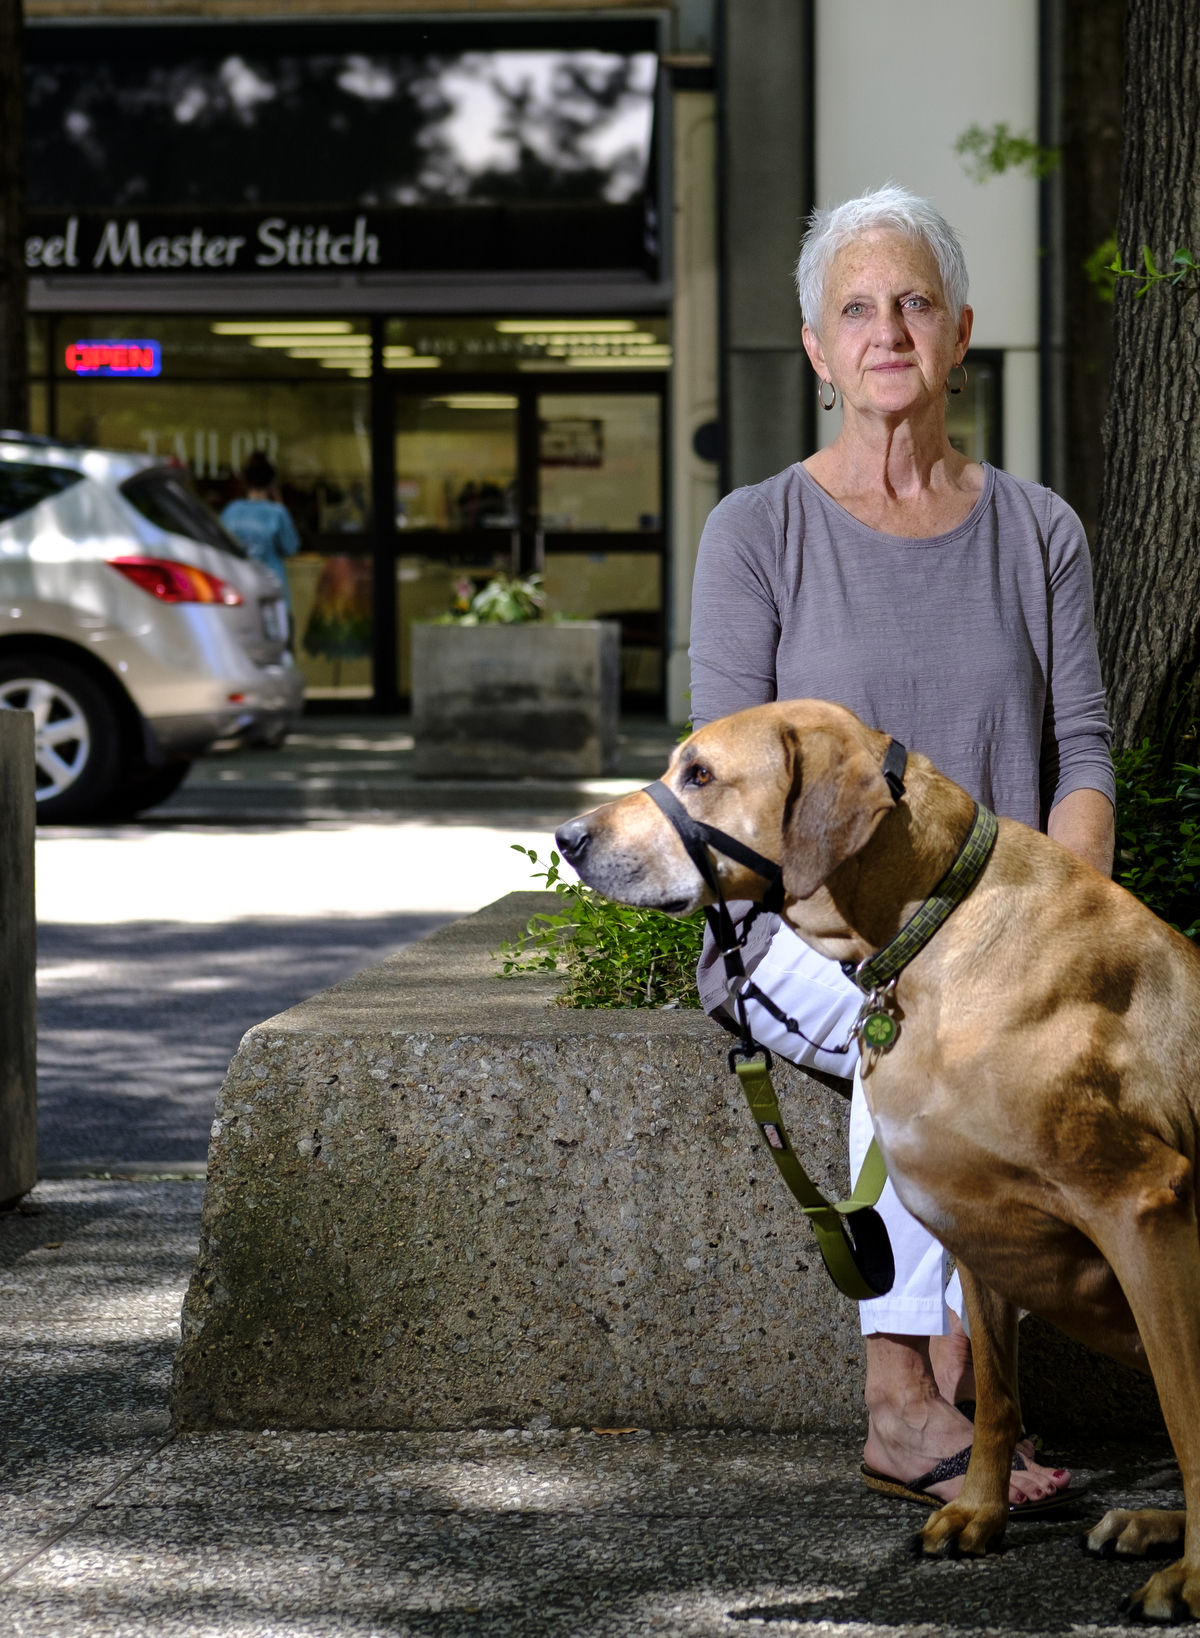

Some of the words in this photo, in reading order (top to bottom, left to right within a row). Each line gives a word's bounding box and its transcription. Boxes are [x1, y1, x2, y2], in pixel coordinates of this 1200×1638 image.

[26, 216, 79, 267] eel
[93, 219, 246, 268] Master
[255, 214, 380, 266] Stitch
[65, 344, 153, 371] OPEN
